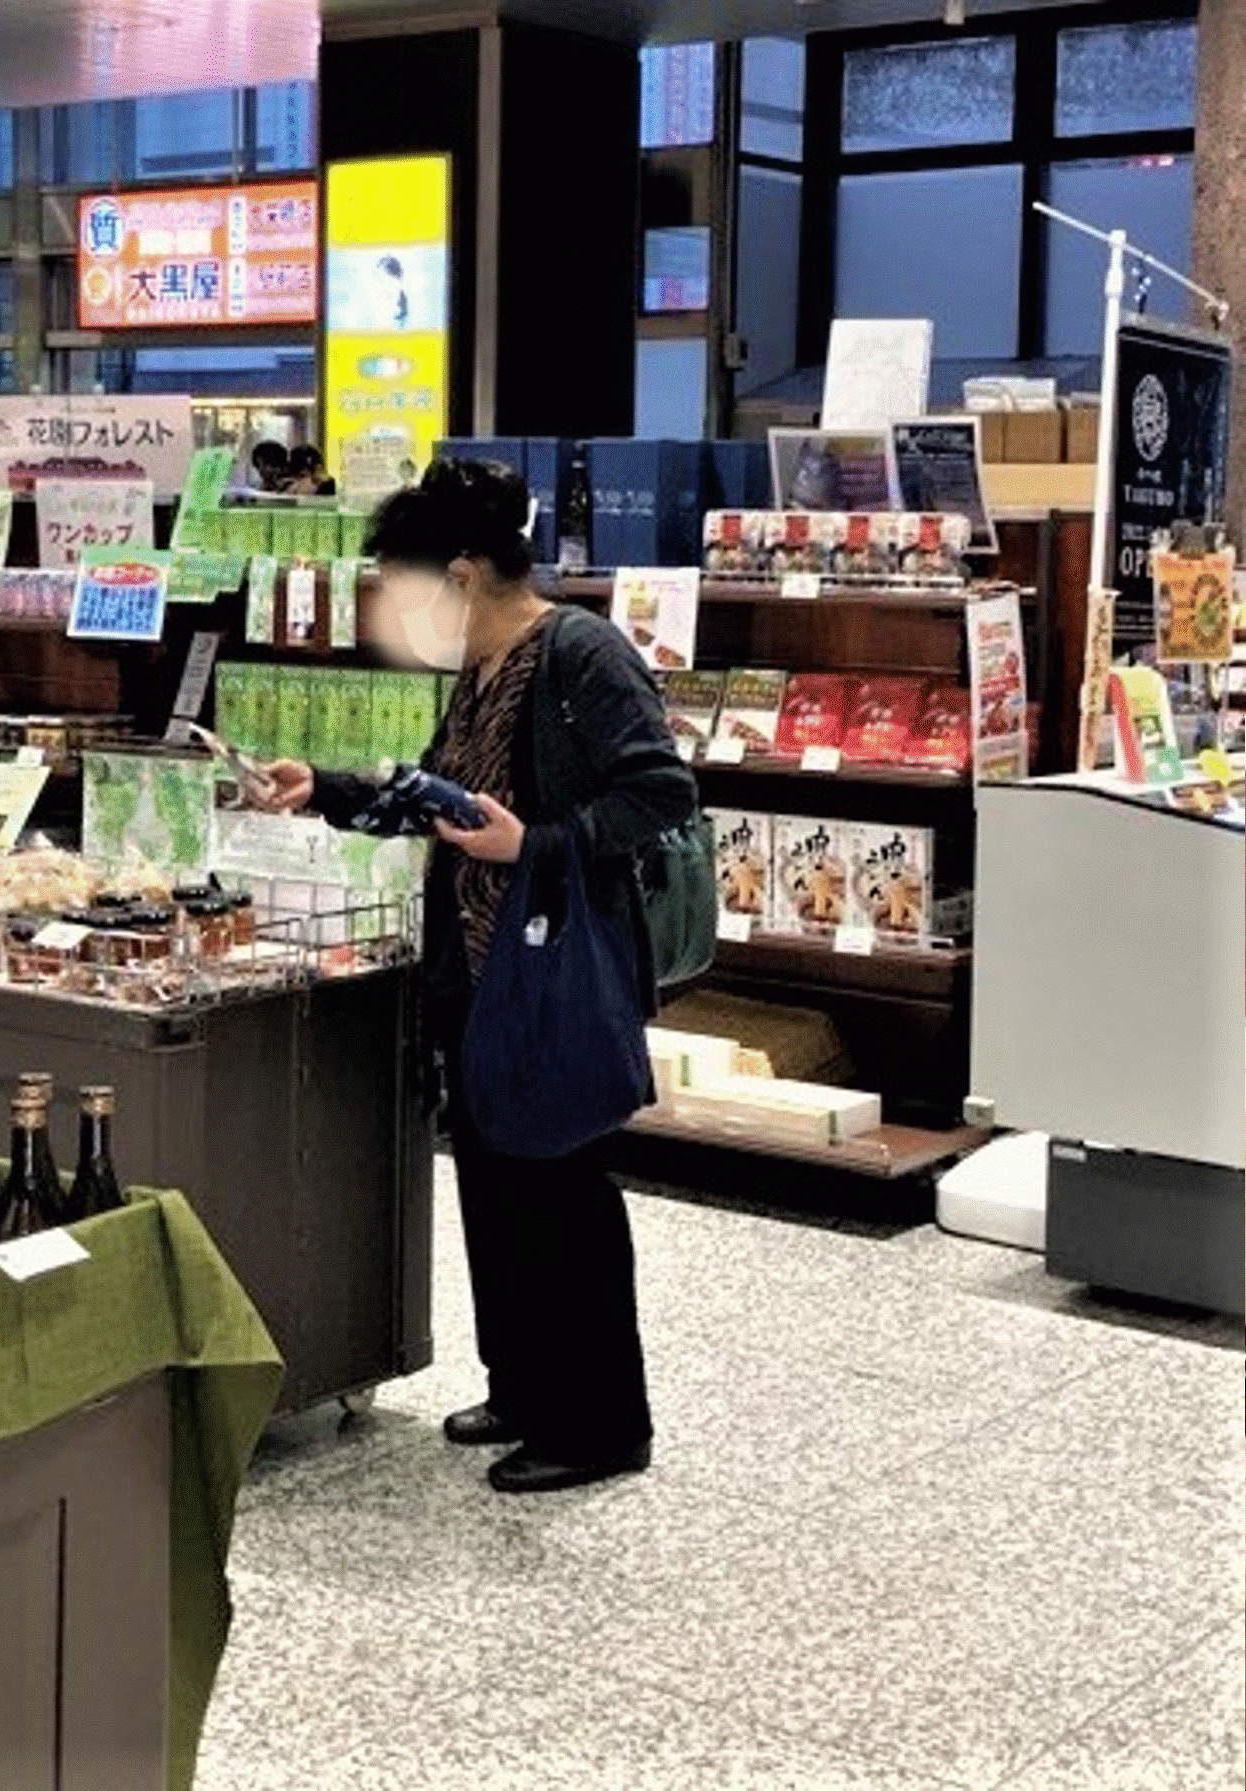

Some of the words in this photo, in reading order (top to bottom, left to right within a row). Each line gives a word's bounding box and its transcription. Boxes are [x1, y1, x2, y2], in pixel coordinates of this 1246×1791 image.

[128, 262, 220, 303] 大黒屋
[26, 418, 175, 447] 花園フォレスト
